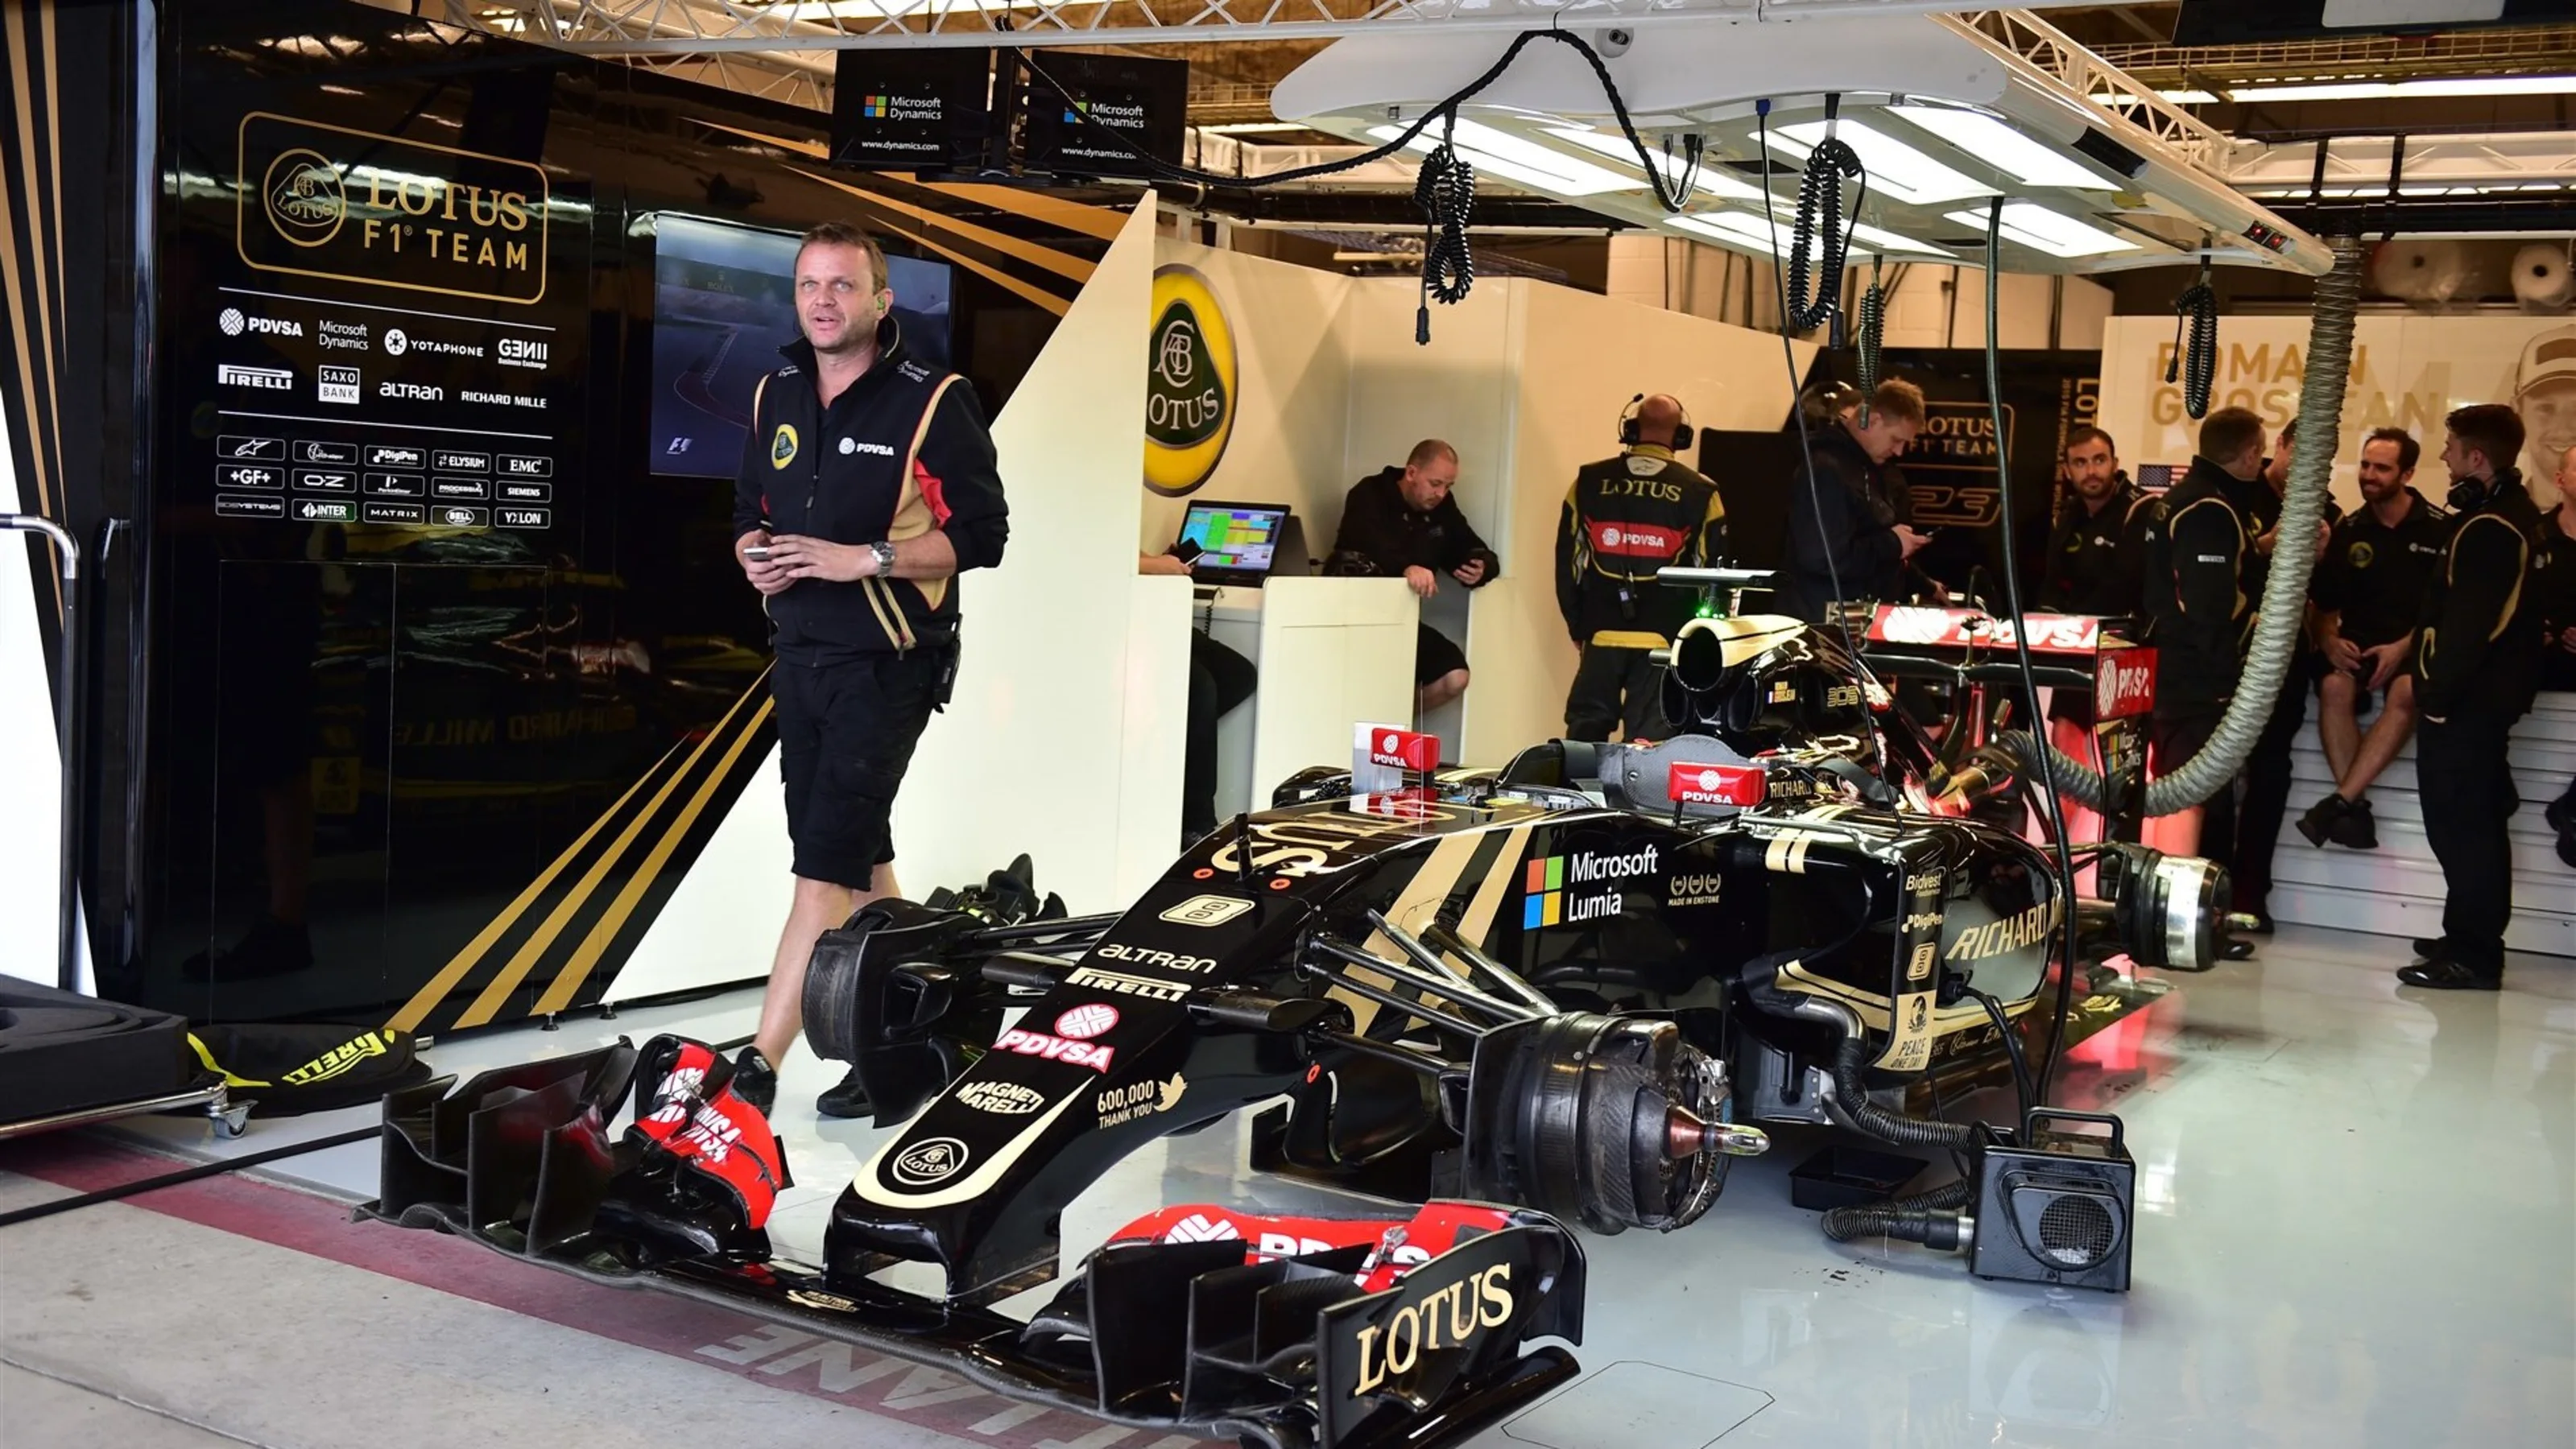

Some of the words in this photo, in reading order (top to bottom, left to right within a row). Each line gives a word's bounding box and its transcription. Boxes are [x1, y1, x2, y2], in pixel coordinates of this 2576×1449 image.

[890, 96, 941, 109] Microsoft
[1090, 102, 1144, 117] Microsoft
[889, 107, 942, 121] Dynamics
[1090, 115, 1144, 129] Dynamics
[862, 140, 940, 151] www.dynamics.com
[277, 194, 333, 219] LOTUS
[366, 173, 528, 232] LOTUS
[426, 229, 527, 271] TEAM
[248, 316, 304, 337] PDVSA
[319, 320, 368, 336] Microsoft
[319, 334, 369, 351] Dynamics
[410, 340, 484, 357] YOTAPHONE
[218, 364, 293, 390] PIRELLI
[322, 370, 357, 384] SAXO
[322, 386, 357, 400] BANK
[461, 390, 511, 405] RICHARD
[514, 395, 548, 409] MILLE
[1147, 387, 1219, 431] OTUS
[1925, 416, 1996, 439] OTUS
[385, 450, 418, 462] DigiPen
[857, 443, 895, 456] PDVSA
[449, 456, 486, 469] ELYSIUM
[507, 487, 541, 497] SIEMENS
[316, 505, 347, 518] INTER
[370, 509, 419, 518] MATRIX
[449, 512, 472, 521] BELL
[505, 512, 542, 524] YXLON
[1623, 532, 1665, 547] PDVSA
[1374, 753, 1408, 769] PDVSA
[1682, 791, 1733, 805] PDVSA
[1570, 844, 1659, 883] Microsoft
[1568, 887, 1623, 923] Lumia
[1668, 897, 1685, 906] MADE
[1685, 897, 1693, 905] IN
[1945, 902, 2047, 961] RICHARD
[1065, 967, 1192, 1002] PIRELLI
[992, 1029, 1115, 1073] PDVSA
[1098, 1080, 1156, 1113] 600,000
[1098, 1111, 1131, 1129] THANK
[1132, 1102, 1152, 1121] YOU
[906, 1156, 949, 1172] LOTUS
[1353, 1261, 1514, 1397] LOTUS
